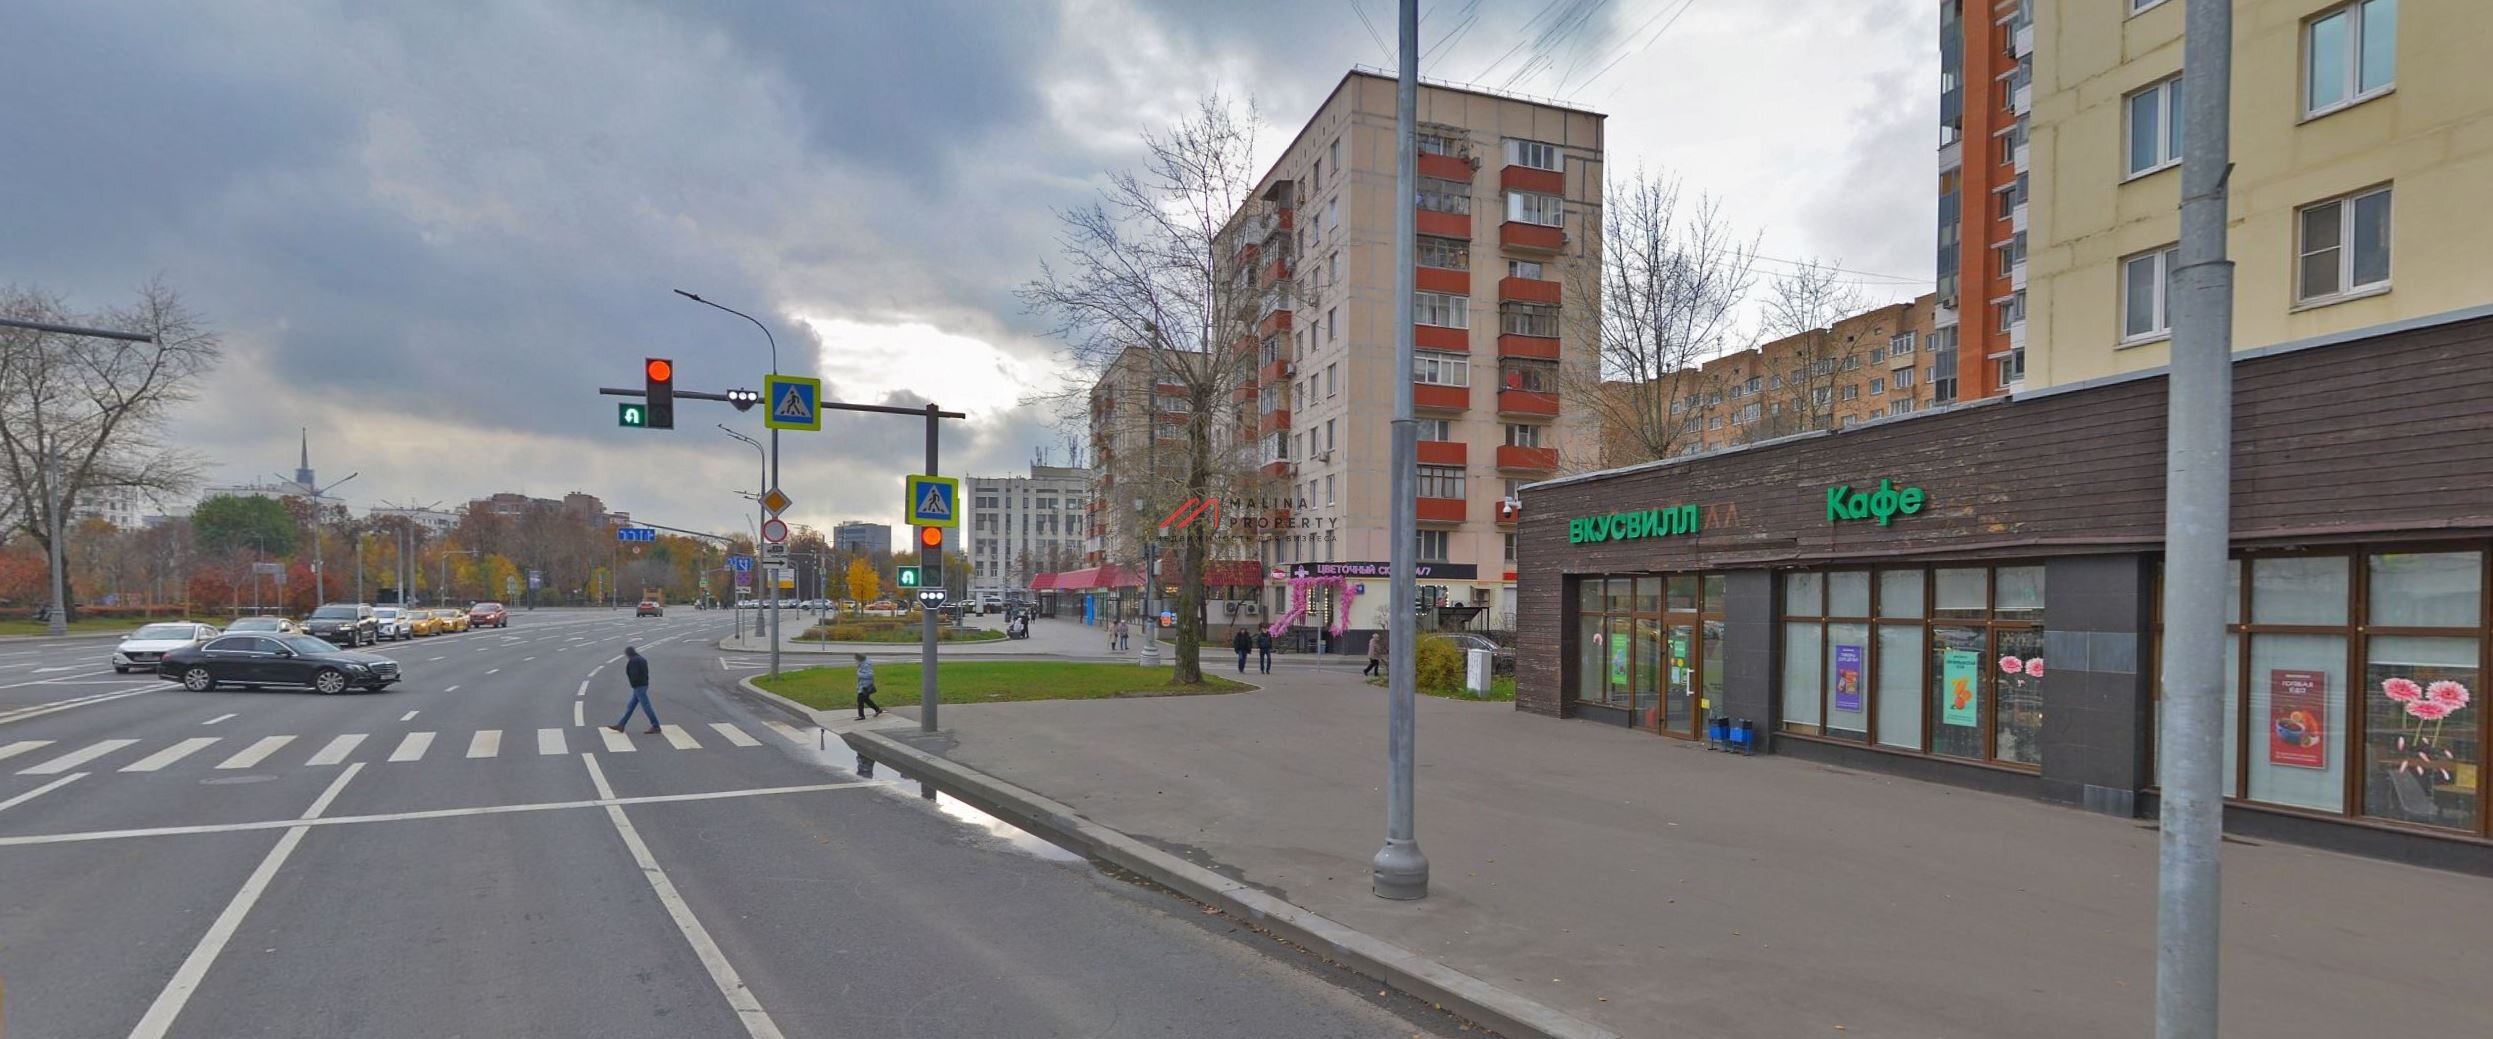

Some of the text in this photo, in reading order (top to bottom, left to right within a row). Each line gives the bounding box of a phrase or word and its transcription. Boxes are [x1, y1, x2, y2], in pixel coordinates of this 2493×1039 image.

[1826, 478, 1925, 526] Кафе
[1569, 503, 1699, 544] ВКУСВИЛЛ
[1317, 564, 1376, 575] ЦВЕТОЧНЫЙ
